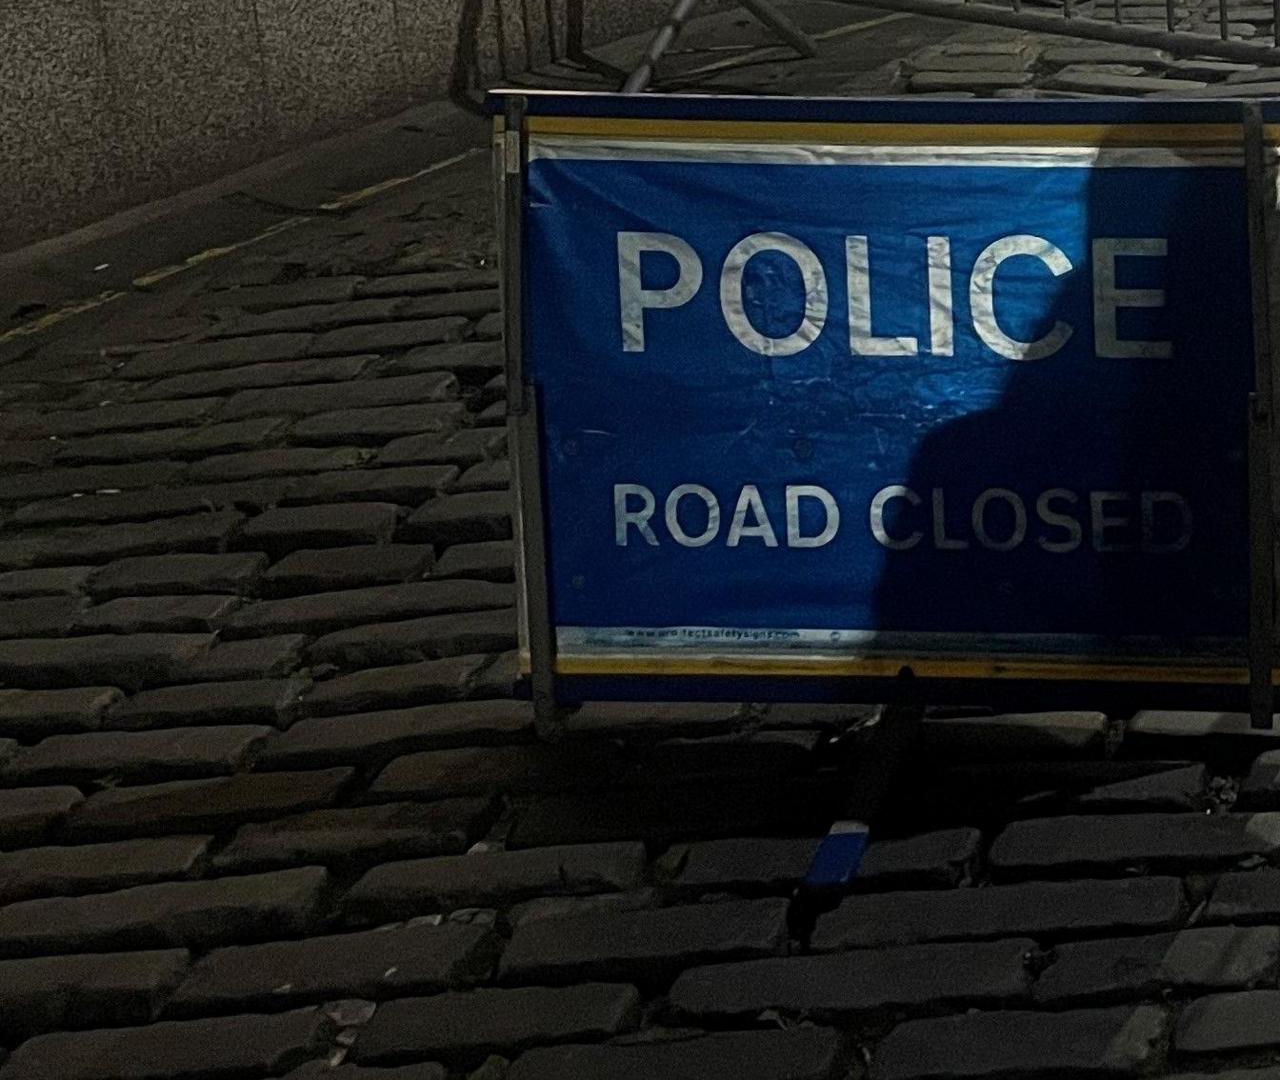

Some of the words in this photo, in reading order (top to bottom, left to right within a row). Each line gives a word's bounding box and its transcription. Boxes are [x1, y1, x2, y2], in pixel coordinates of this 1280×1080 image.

[615, 230, 1173, 361] POLICE
[613, 483, 840, 551] ROAD
[869, 484, 1193, 554] CLOSED
